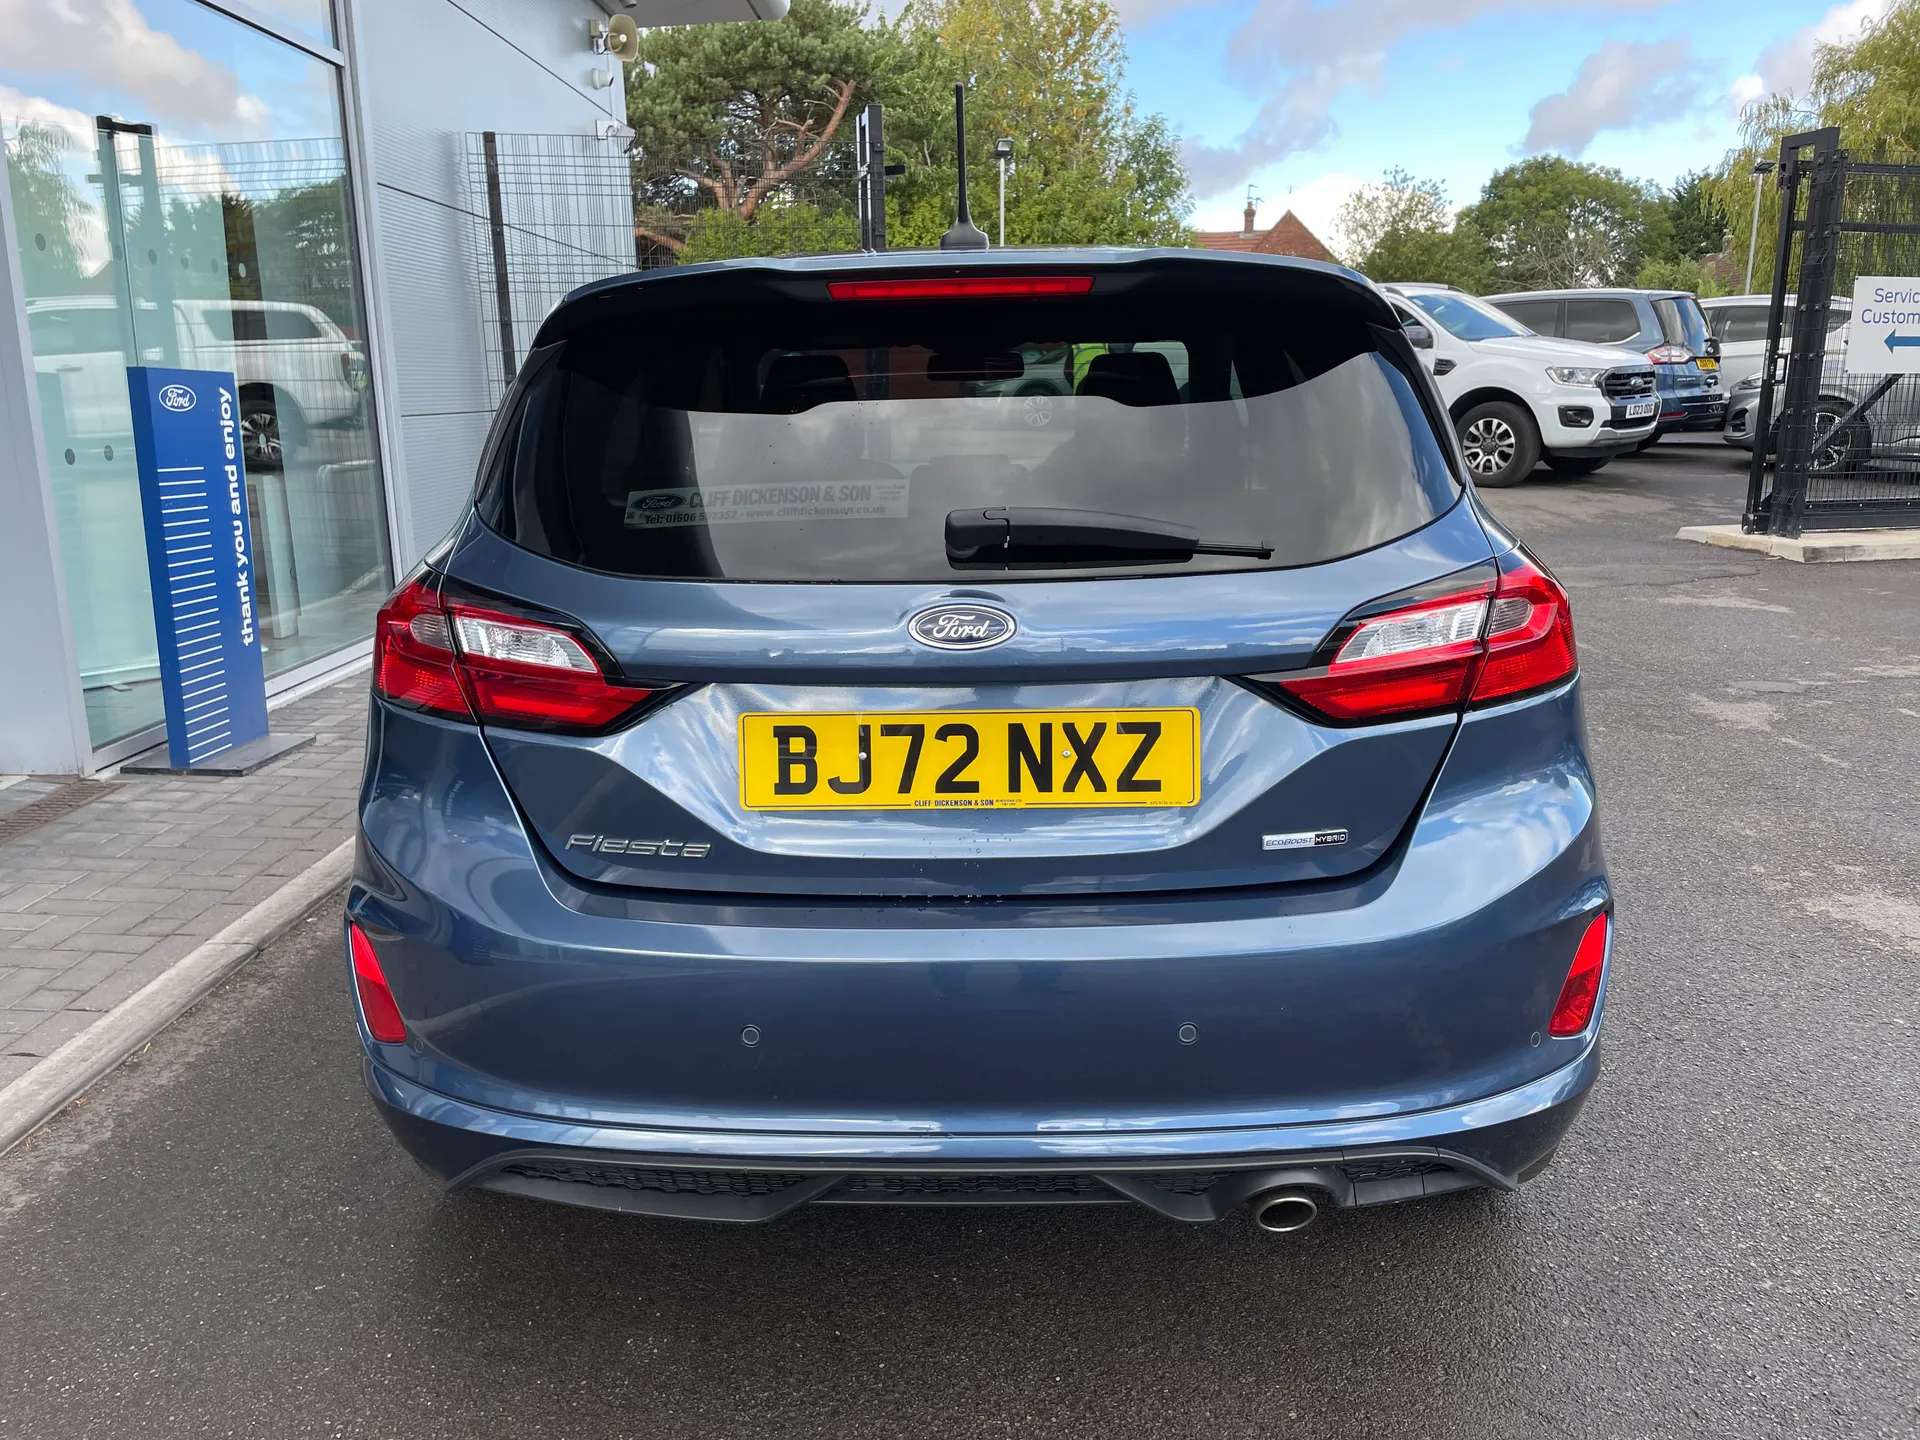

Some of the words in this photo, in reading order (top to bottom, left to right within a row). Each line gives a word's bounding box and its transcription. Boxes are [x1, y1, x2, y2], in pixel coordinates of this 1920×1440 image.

[1873, 287, 1920, 304] Servic
[1861, 308, 1920, 324] Custom
[166, 388, 190, 408] Ford
[217, 386, 236, 460] enjoy
[224, 466, 241, 515] and
[689, 490, 731, 508] CLIFF
[732, 485, 820, 506] DICKENSON
[822, 486, 834, 502] &
[838, 485, 872, 502] SON
[642, 496, 674, 509] Ford
[232, 519, 248, 566] you
[236, 570, 254, 646] thank
[932, 614, 990, 638] Ford
[772, 723, 980, 795] BJ72
[1007, 721, 1162, 793] NXZ
[914, 799, 931, 807] CLIFF
[934, 799, 972, 807] DICKENSON
[973, 799, 979, 807] &
[980, 799, 994, 807] SON
[564, 834, 711, 858] Fiesta
[1315, 833, 1346, 844] HYBRID
